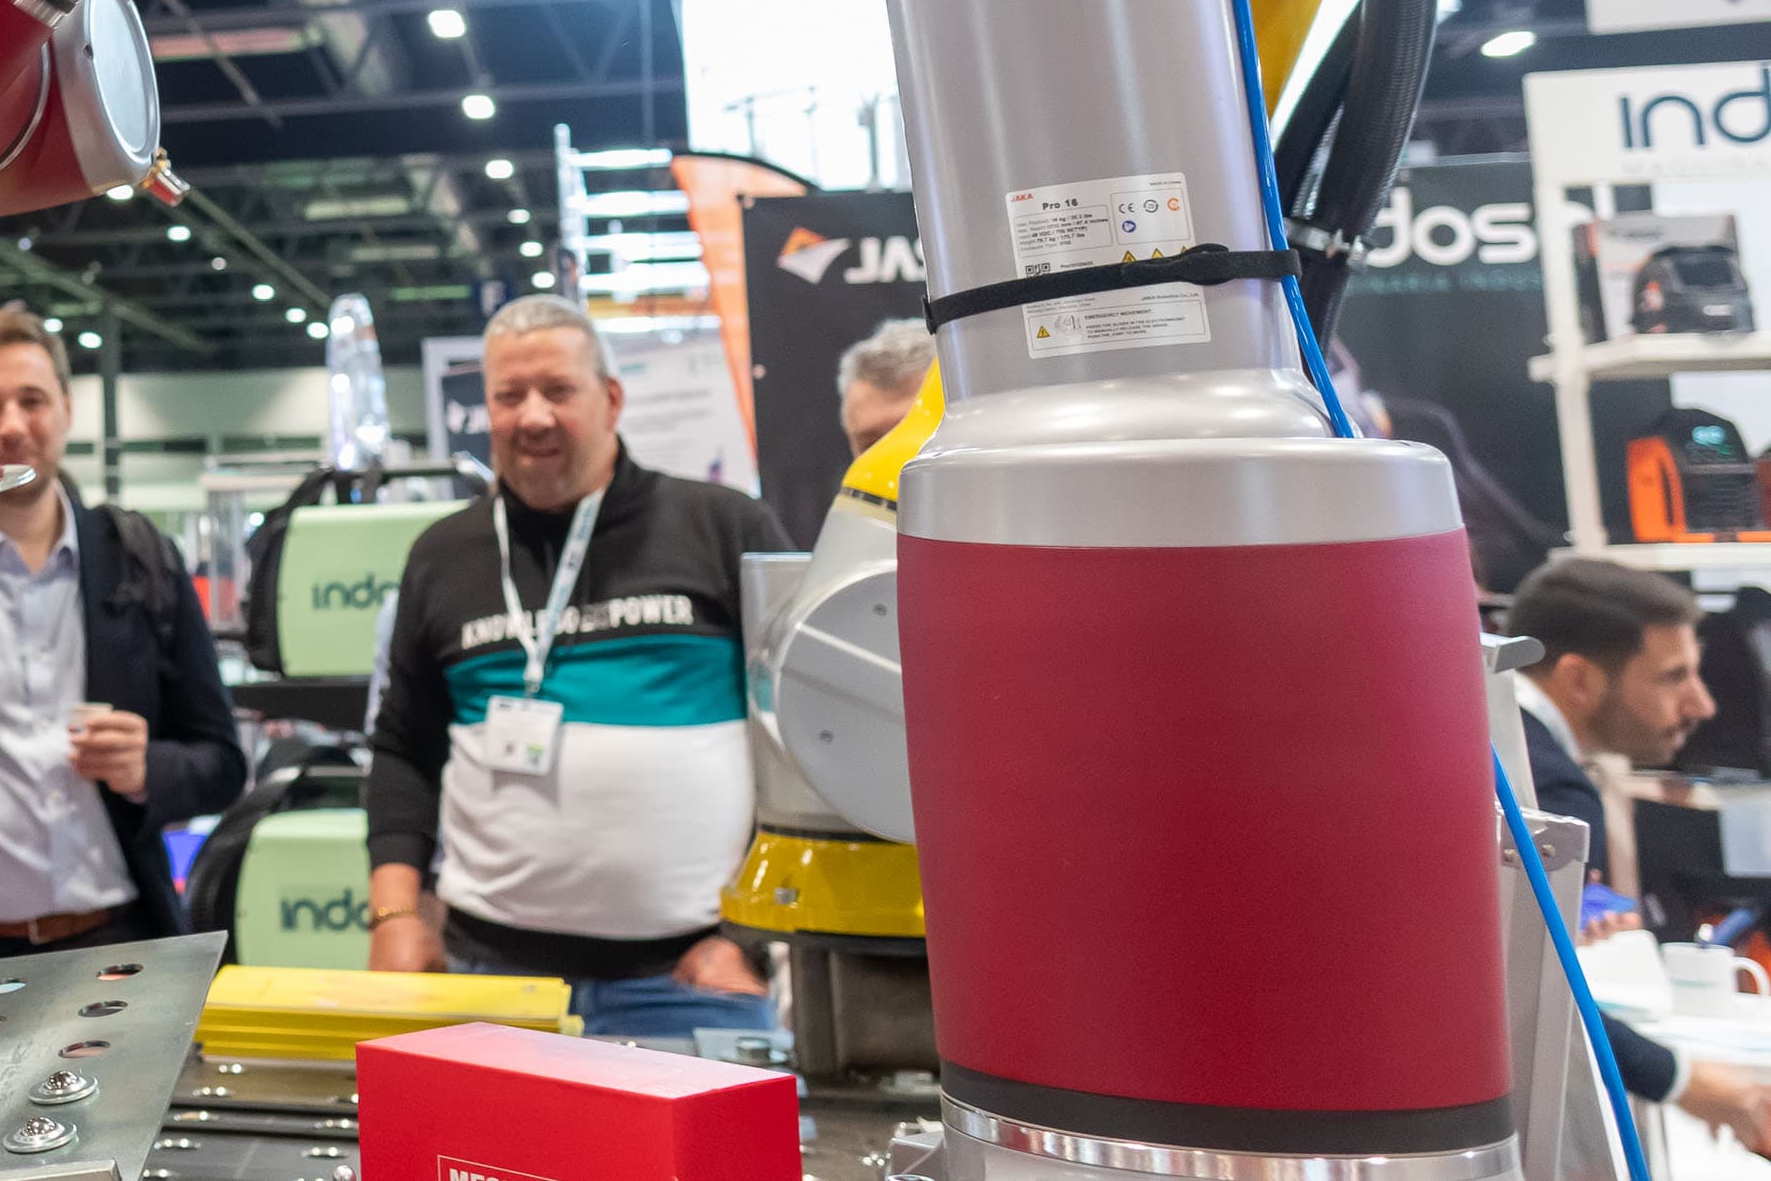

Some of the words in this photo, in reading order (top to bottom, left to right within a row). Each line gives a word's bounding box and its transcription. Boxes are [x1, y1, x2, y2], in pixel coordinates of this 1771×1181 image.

[1012, 194, 1033, 202] JAKA
[1043, 202, 1060, 210] Pro
[1065, 198, 1078, 207] 16
[1364, 186, 1537, 268] dos
[608, 594, 694, 629] POWER
